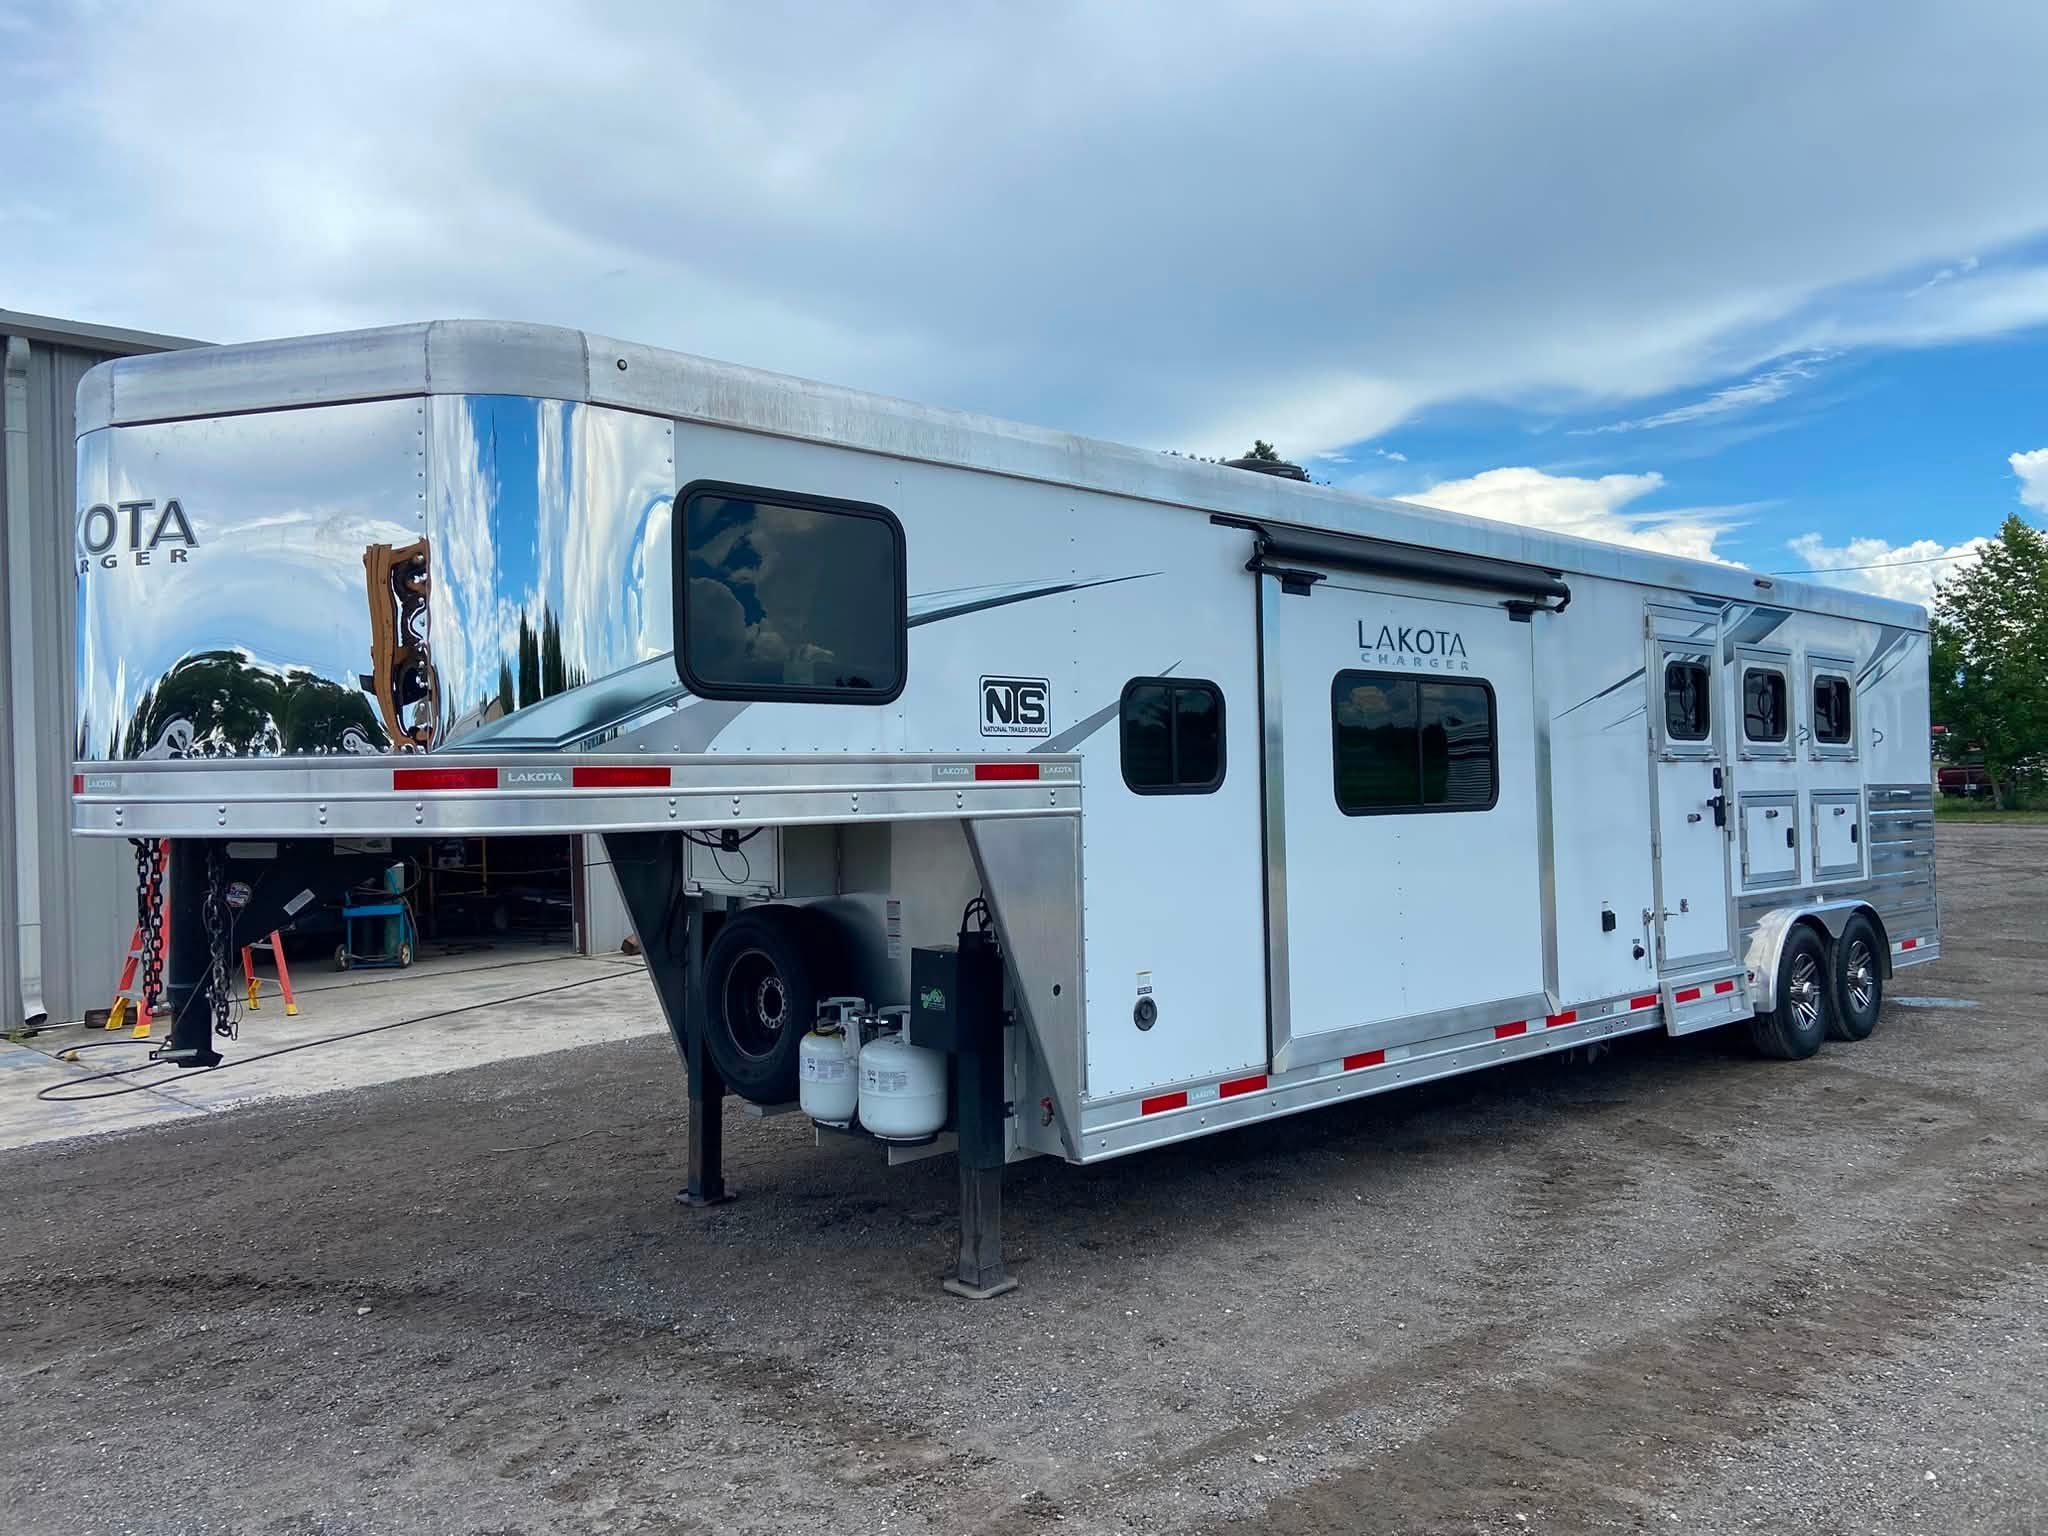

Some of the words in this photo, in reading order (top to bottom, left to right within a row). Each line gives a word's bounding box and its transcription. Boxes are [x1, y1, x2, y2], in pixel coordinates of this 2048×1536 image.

[1357, 619, 1467, 658] LAKOTA
[1360, 652, 1470, 671] CHARGER
[937, 767, 970, 776] LAKOTA
[1044, 766, 1073, 774] LAKOTA
[507, 772, 563, 782] LAKOTA
[87, 779, 118, 789] LAKOTA
